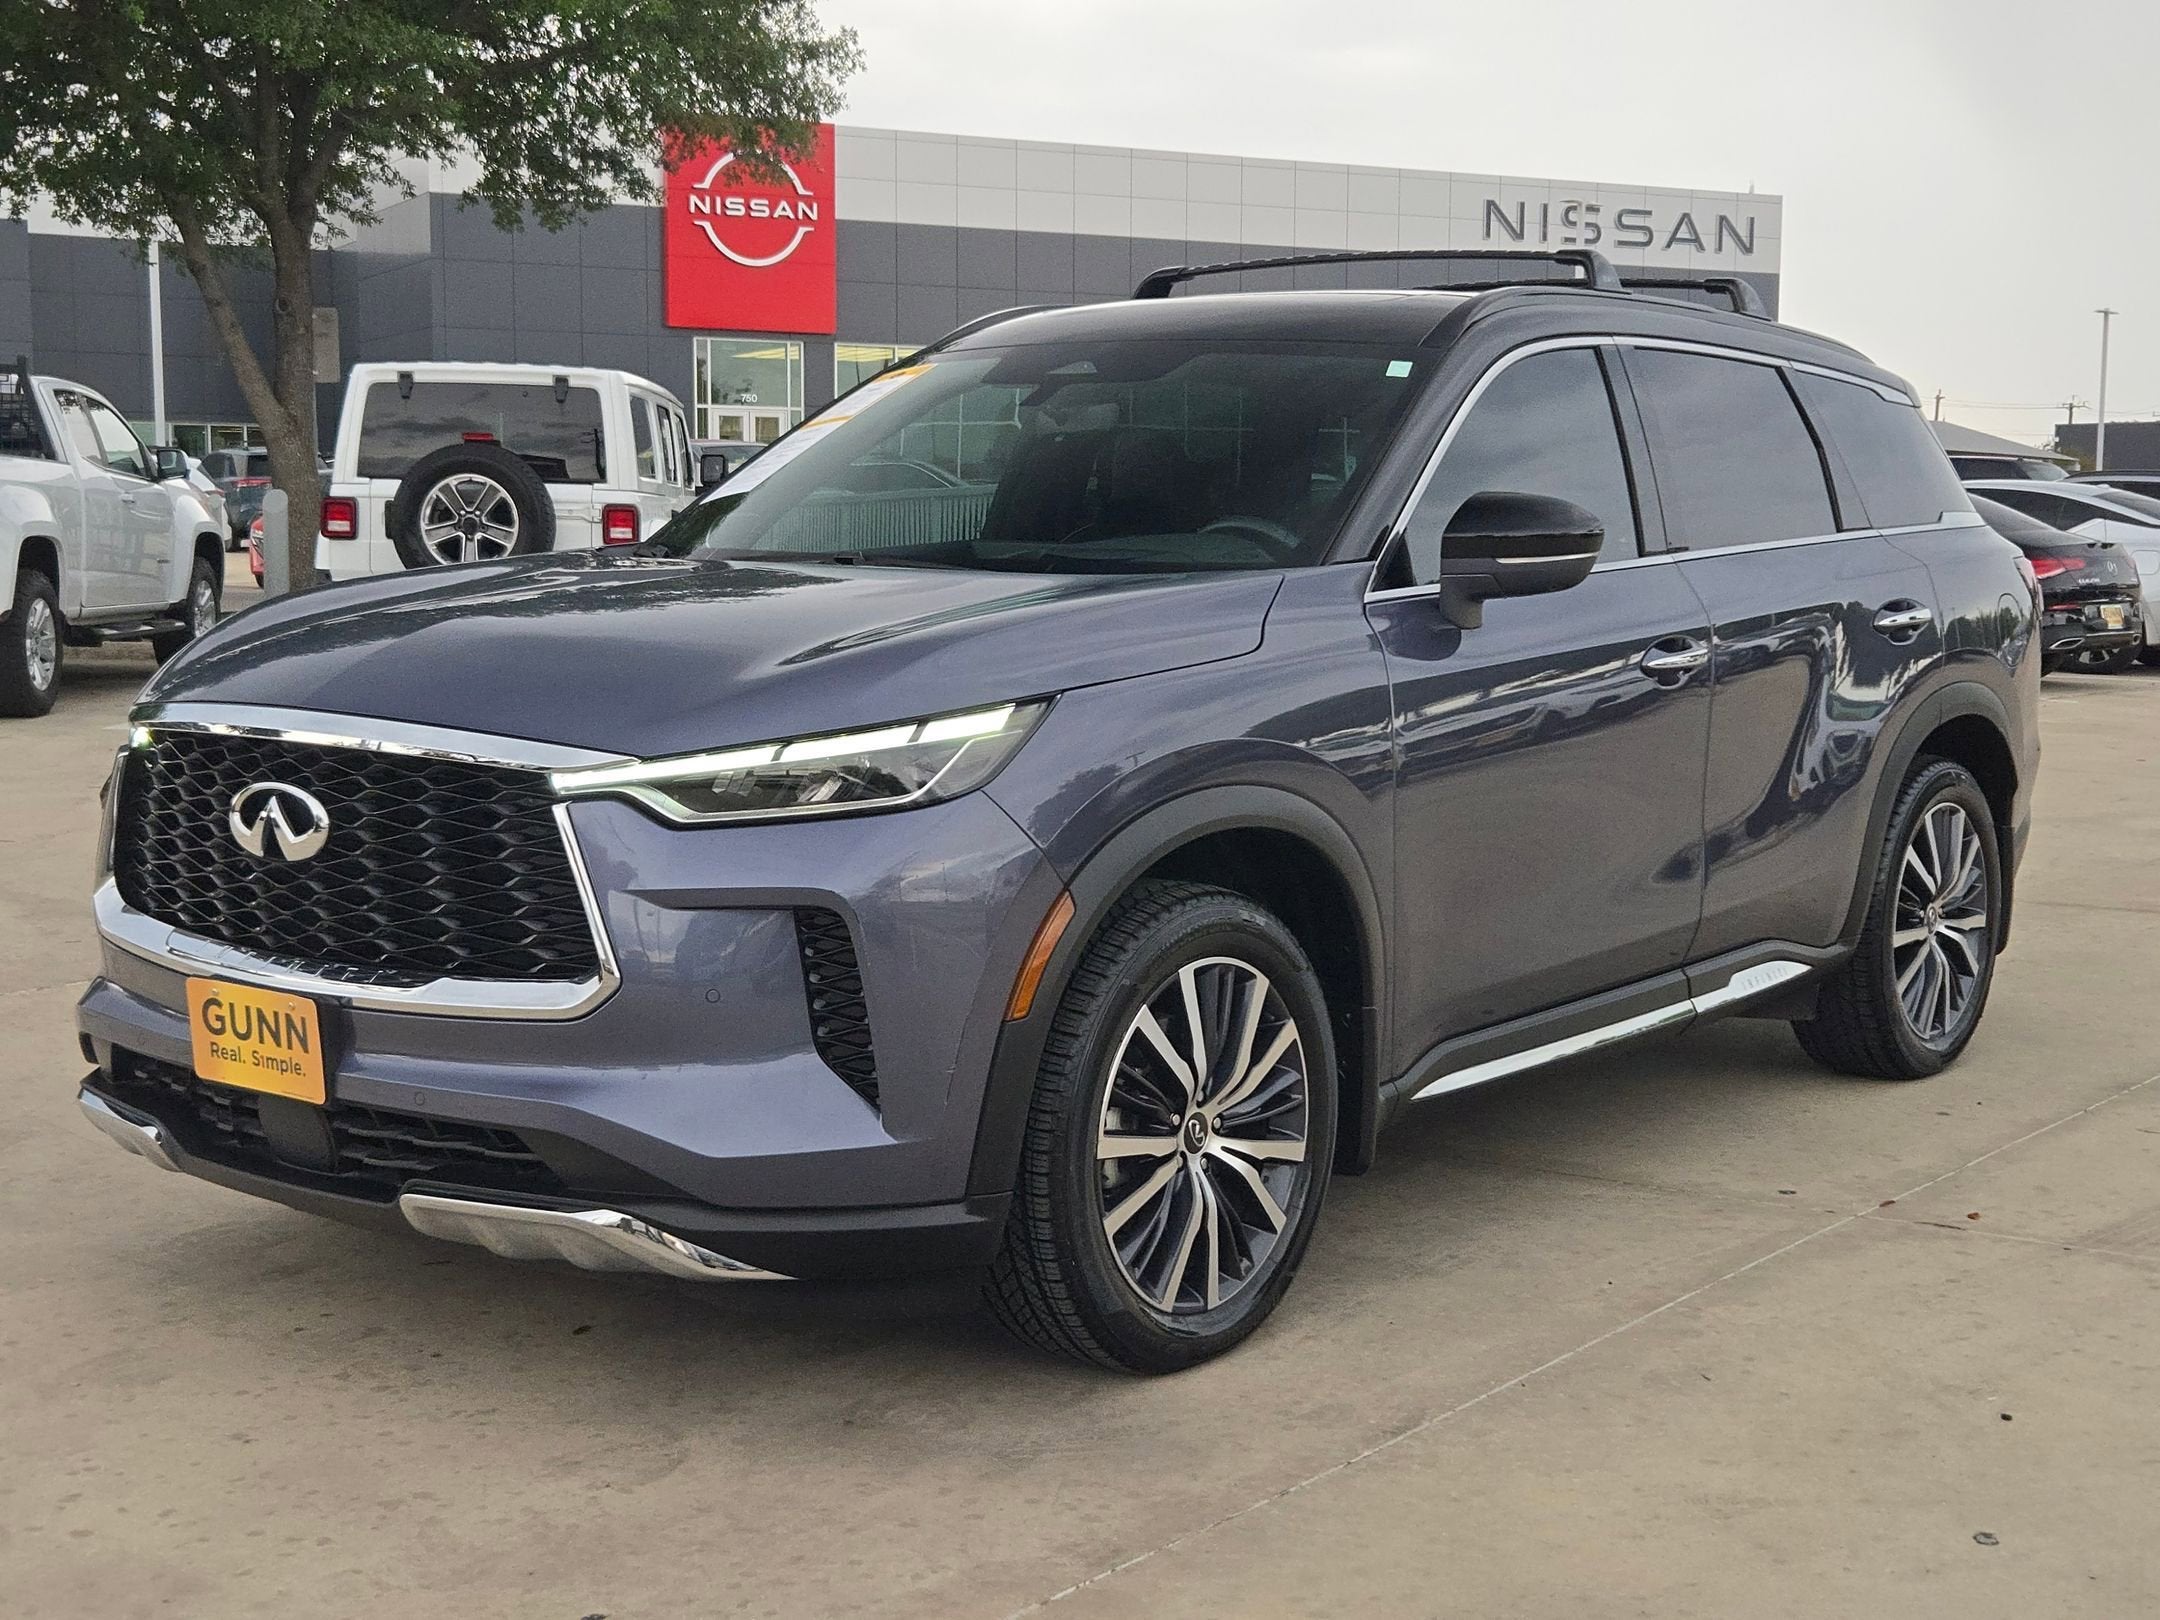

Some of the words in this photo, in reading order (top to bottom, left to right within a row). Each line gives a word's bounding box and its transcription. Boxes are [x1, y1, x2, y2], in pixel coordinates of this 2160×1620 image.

[689, 194, 818, 220] NISSAN
[1483, 199, 1755, 256] NISSAN
[740, 393, 758, 403] 750
[201, 997, 310, 1054] GUNN
[210, 1041, 246, 1064] Real.
